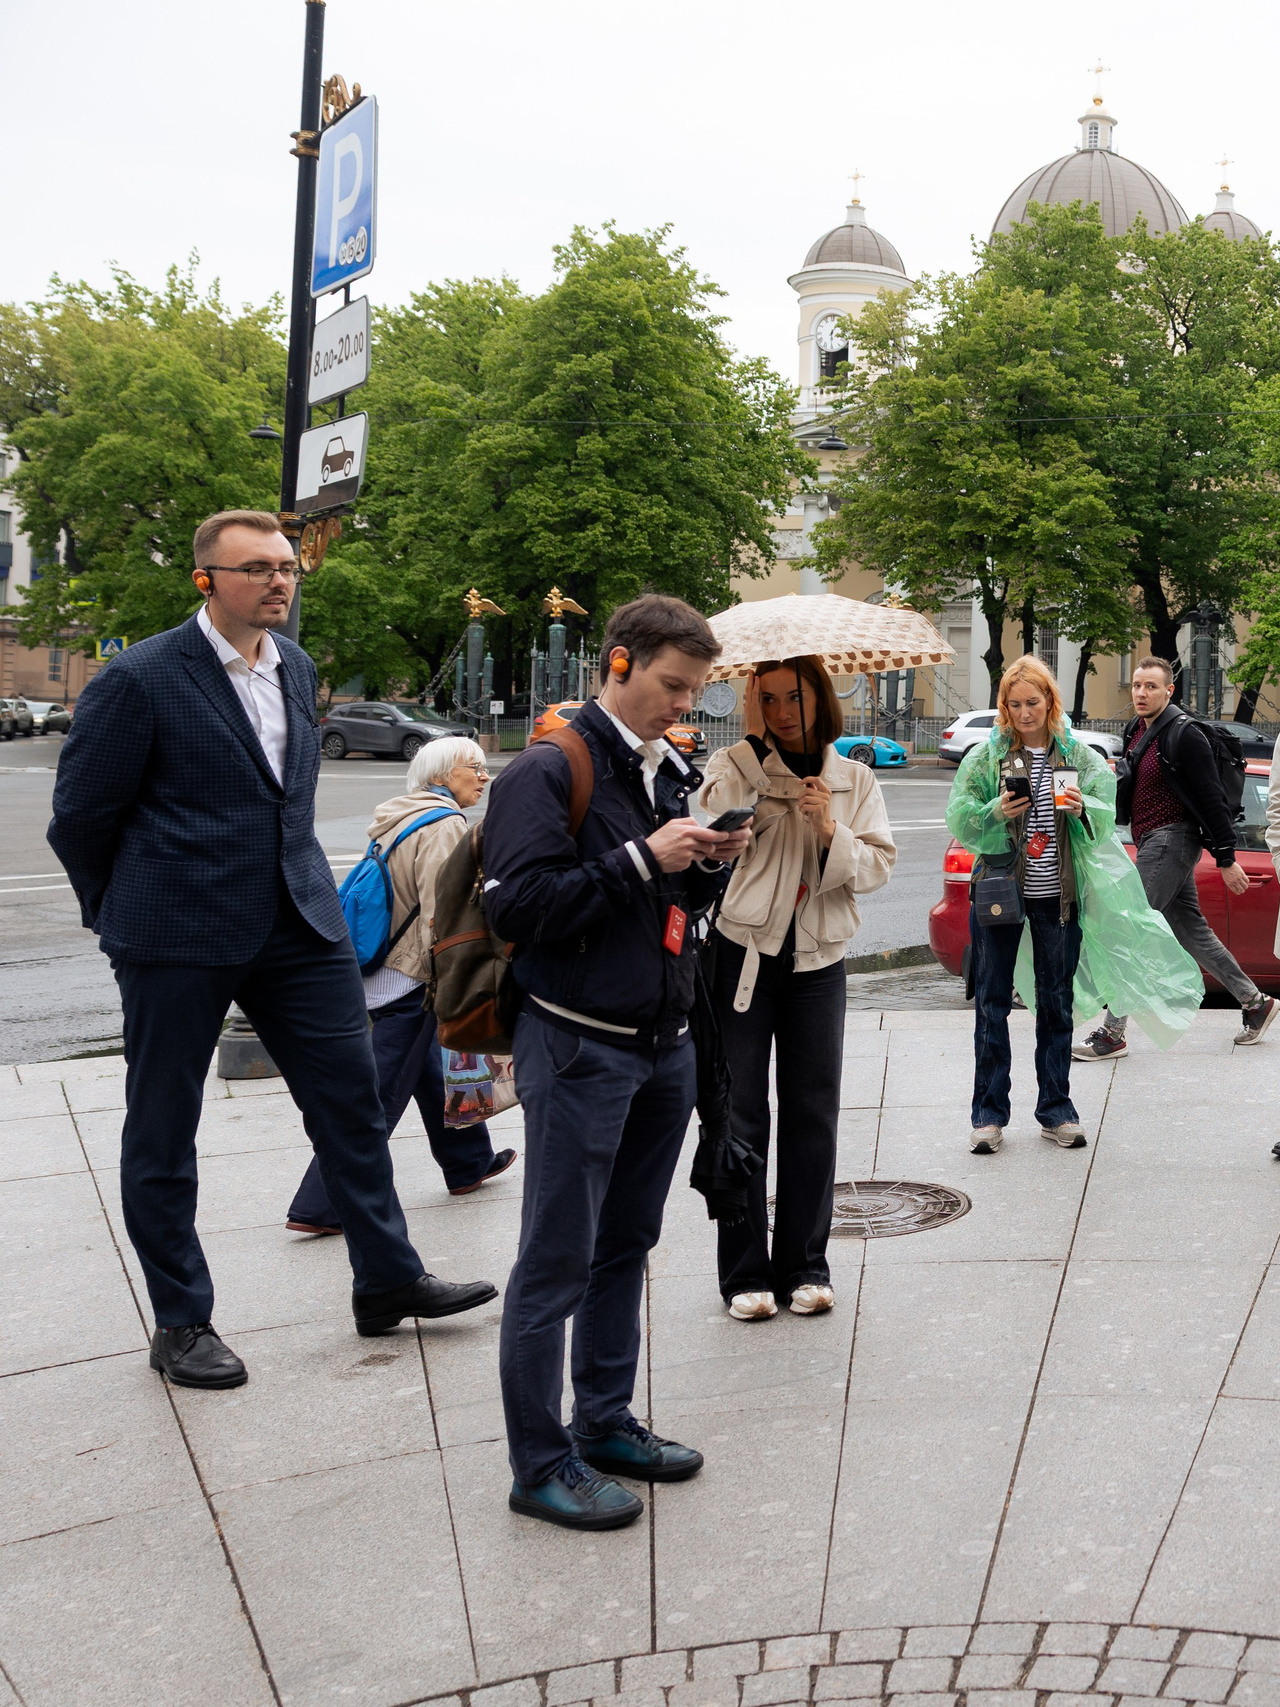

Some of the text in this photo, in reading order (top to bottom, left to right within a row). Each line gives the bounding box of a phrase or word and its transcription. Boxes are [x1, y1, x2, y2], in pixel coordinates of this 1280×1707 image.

[328, 132, 363, 269] P
[356, 231, 366, 257] 20
[313, 331, 363, 377] 8.00-20.00
